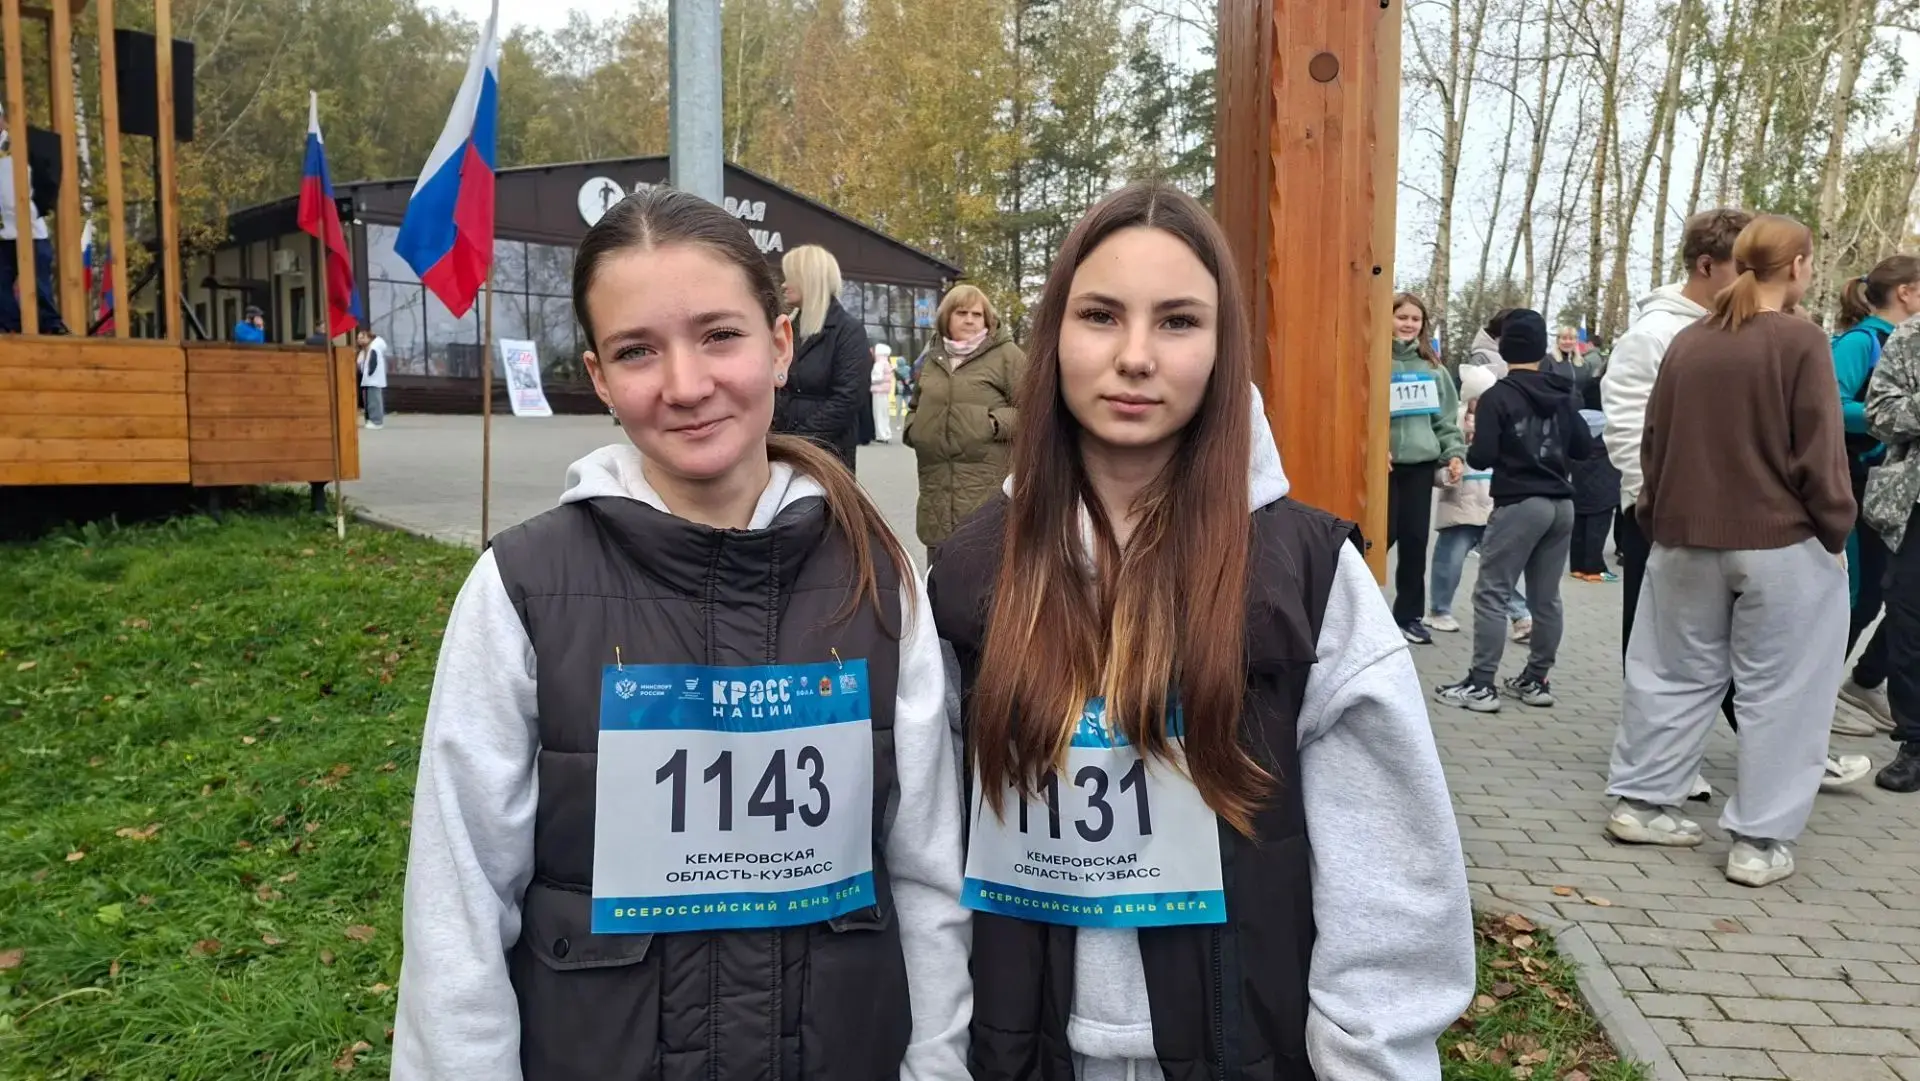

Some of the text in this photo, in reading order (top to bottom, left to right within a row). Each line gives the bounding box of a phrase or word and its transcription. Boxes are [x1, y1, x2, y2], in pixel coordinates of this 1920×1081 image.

[1396, 384, 1427, 400] 1171
[712, 678, 791, 705] КРОСС
[712, 705, 792, 718] НАЦИИ
[655, 745, 831, 833] 1143
[685, 848, 815, 865] КЕМЕРОВСКАЯ
[1026, 850, 1138, 868] КЕМЕРОВСКАЯ
[665, 861, 833, 883] ОБЛАСТЬ-КУЗБАСС
[1014, 863, 1161, 883] ОБЛАСТЬ-КУЗБАСС
[614, 885, 861, 917] ВСЕРОССИЙСКИЙ ДЕНЬ БЕГА
[980, 889, 1208, 915] ВСЕРОССИЙСКИЙ ДЕНЬ БЕГА
